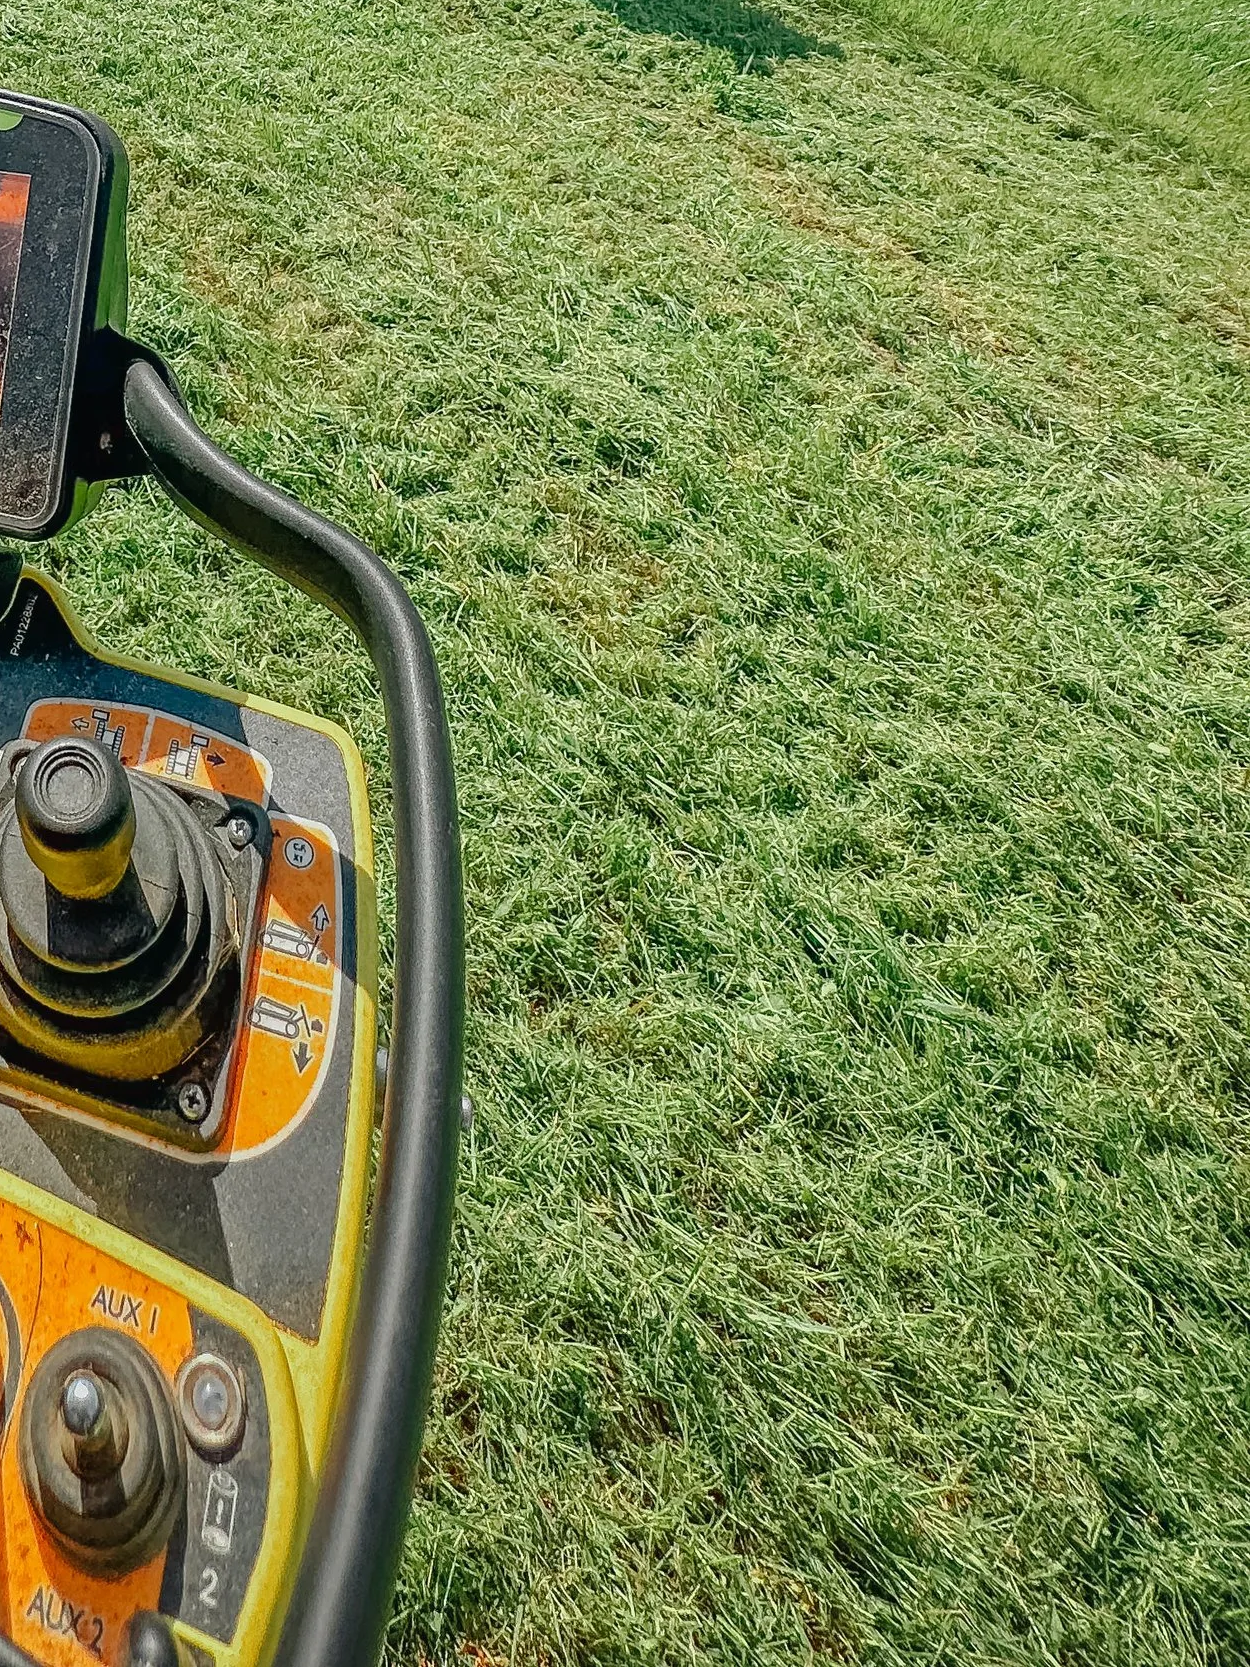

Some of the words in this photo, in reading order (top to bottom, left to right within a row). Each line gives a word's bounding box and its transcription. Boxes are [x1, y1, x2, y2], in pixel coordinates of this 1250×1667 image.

[90, 1285, 143, 1327] AUX
[199, 1565, 220, 1609] 2
[26, 1584, 85, 1644] AUX
[84, 1616, 106, 1660] 2
